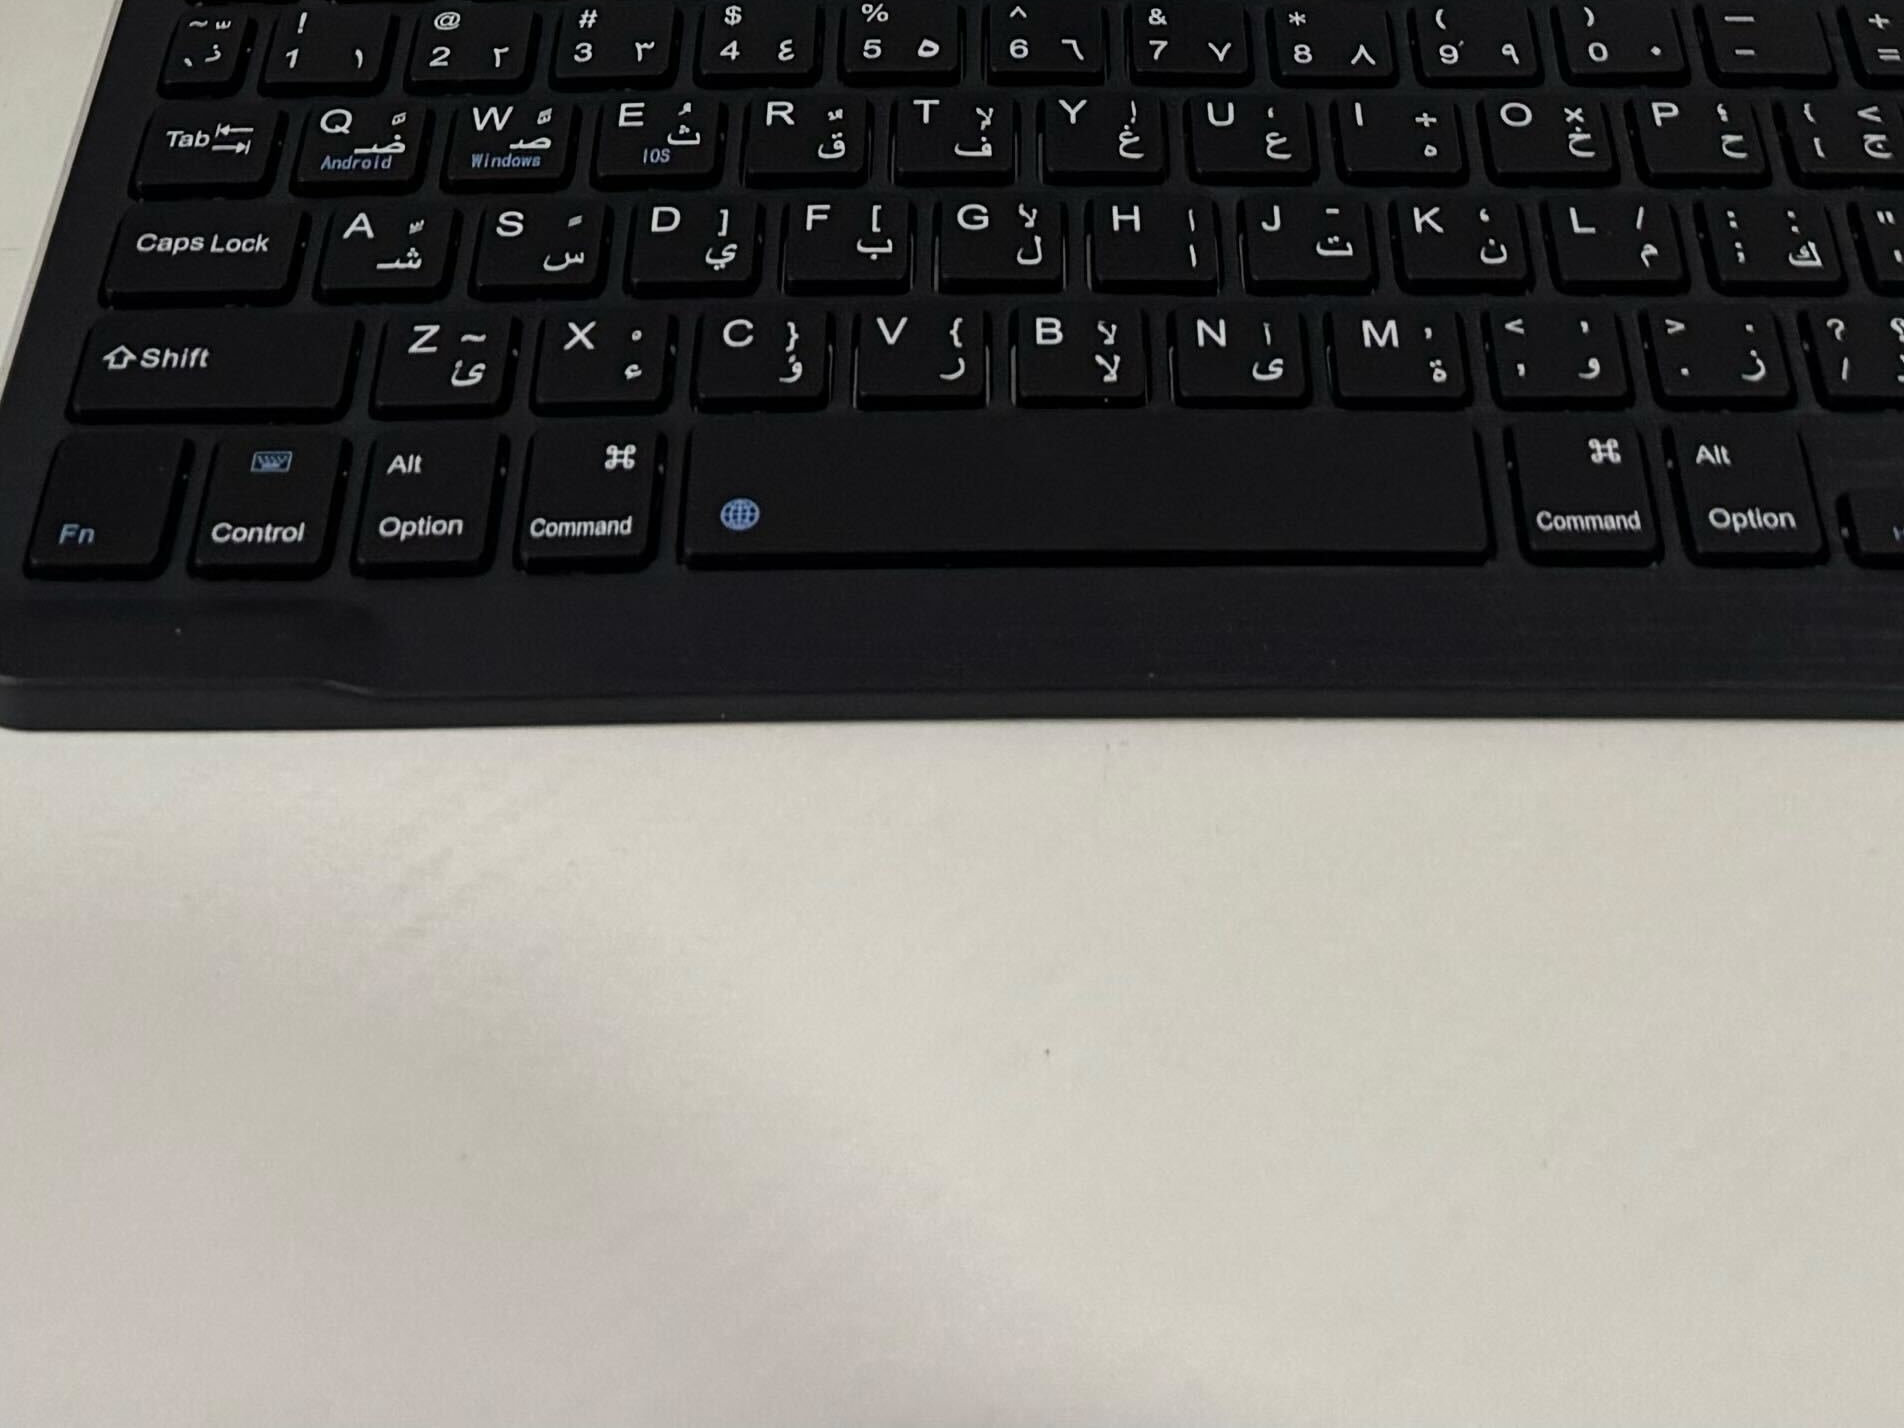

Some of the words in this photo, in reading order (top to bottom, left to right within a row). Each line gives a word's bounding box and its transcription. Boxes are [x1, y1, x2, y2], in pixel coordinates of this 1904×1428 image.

[286, 49, 298, 68] 1
[430, 47, 450, 66] 2
[574, 43, 592, 62] 3
[720, 40, 740, 60] 4
[863, 39, 881, 58] 5
[1010, 39, 1028, 58] 6
[1149, 40, 1168, 60] 7
[1294, 44, 1312, 63] 8
[1439, 45, 1458, 64] 9
[1589, 42, 1608, 61] 0
[320, 109, 352, 134] Q
[473, 106, 513, 131] W
[619, 103, 645, 127] E
[766, 101, 794, 126] R
[913, 100, 939, 123] T
[1059, 100, 1087, 124] Y
[1207, 102, 1234, 126] U
[1355, 103, 1363, 126] I
[1500, 103, 1532, 126] O
[1652, 102, 1679, 126] P
[167, 130, 210, 147] Tab
[321, 155, 392, 170] Android
[472, 153, 540, 168] Windows
[343, 213, 374, 239] A
[496, 211, 523, 236] S
[651, 207, 680, 232] D
[806, 205, 830, 230] F
[957, 204, 988, 230] G
[1112, 206, 1140, 232] H
[1262, 205, 1280, 231] J
[1414, 207, 1443, 233] K
[1570, 207, 1595, 233] L
[137, 233, 204, 255] Caps
[210, 234, 269, 252] Lock
[408, 325, 440, 353] Z
[564, 322, 596, 350] X
[723, 319, 753, 347] C
[877, 317, 907, 344] V
[1036, 318, 1063, 344] B
[1197, 319, 1226, 346] N
[1362, 320, 1398, 347] M
[141, 348, 209, 368] Shift
[387, 454, 421, 474] Alt
[1696, 445, 1730, 464] Alt
[212, 522, 305, 543] Control
[379, 516, 463, 541] Option
[530, 516, 632, 537] Command
[1537, 511, 1641, 531] Command
[1709, 508, 1796, 533] Option
[59, 524, 94, 544] Fn
